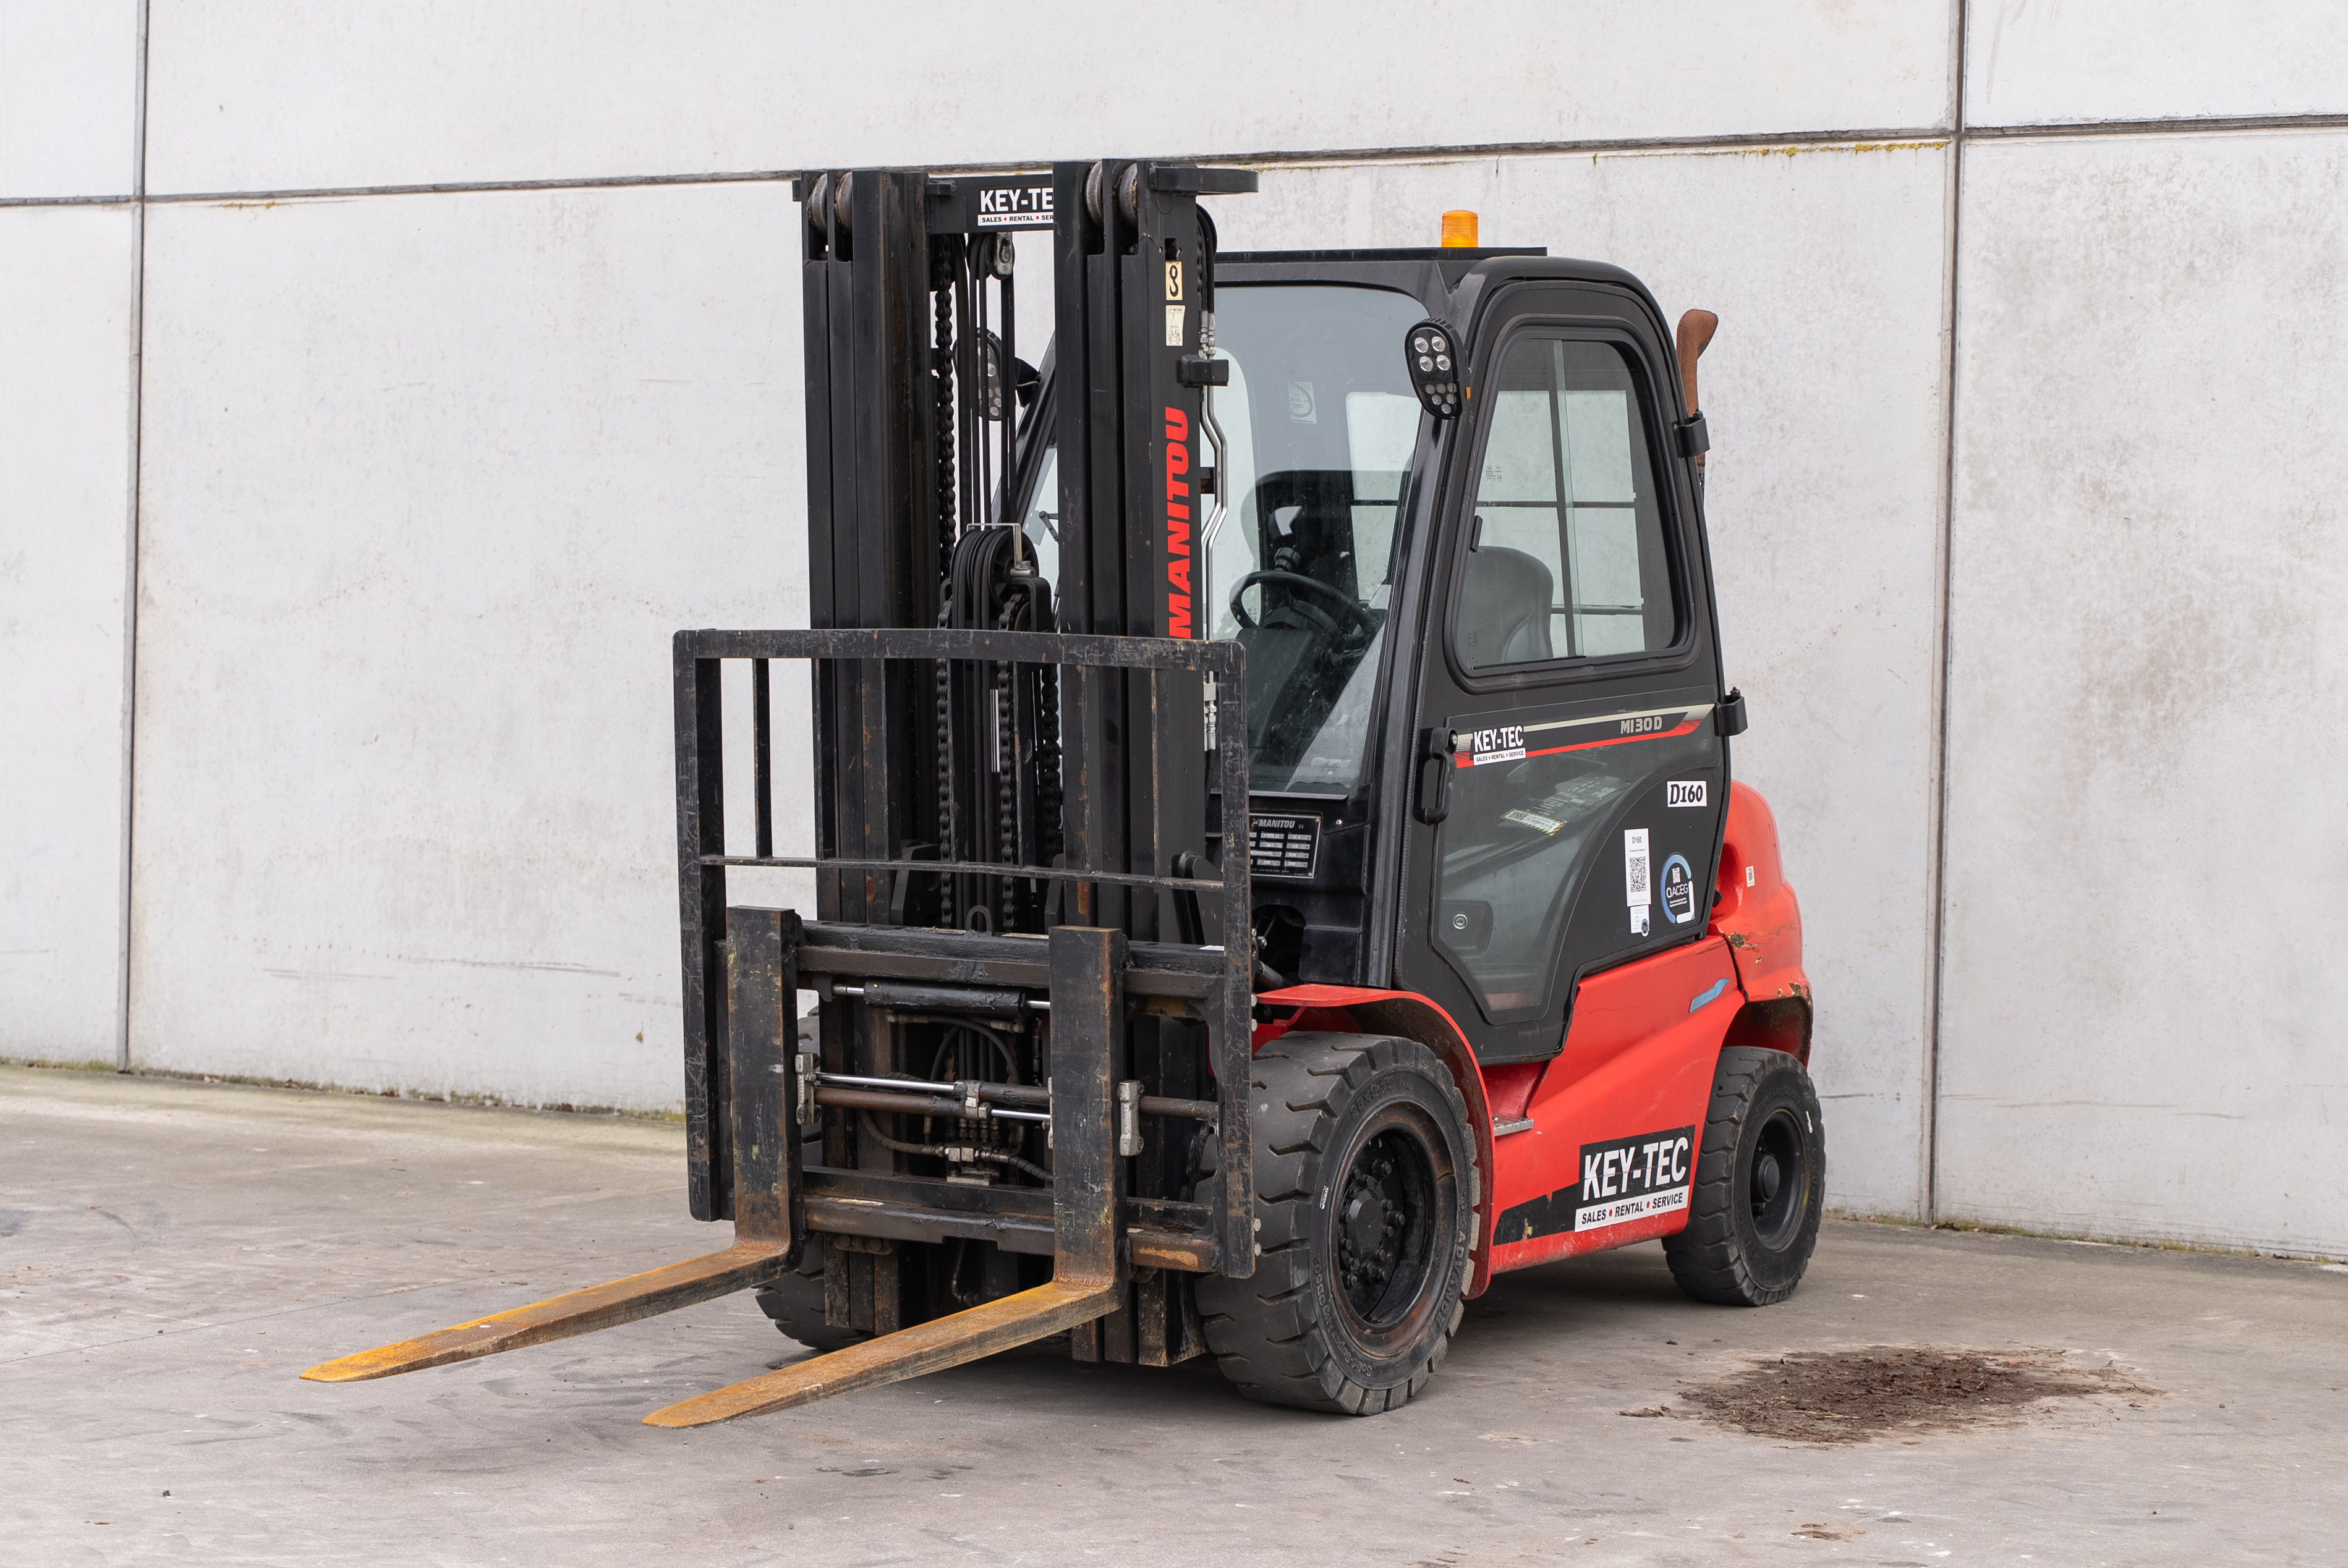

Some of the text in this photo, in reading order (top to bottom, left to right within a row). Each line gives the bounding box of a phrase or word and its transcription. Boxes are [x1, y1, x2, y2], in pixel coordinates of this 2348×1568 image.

[980, 187, 1053, 212] KEY-TE
[1165, 407, 1191, 639] MANITOU
[1474, 725, 1524, 752] KEY-TEC
[1669, 784, 1703, 805] D160
[1258, 819, 1296, 829] MANITOU
[1583, 1137, 1688, 1201] KEY-TEC
[1581, 1192, 1683, 1224] SALES RENTAL SERVICE
